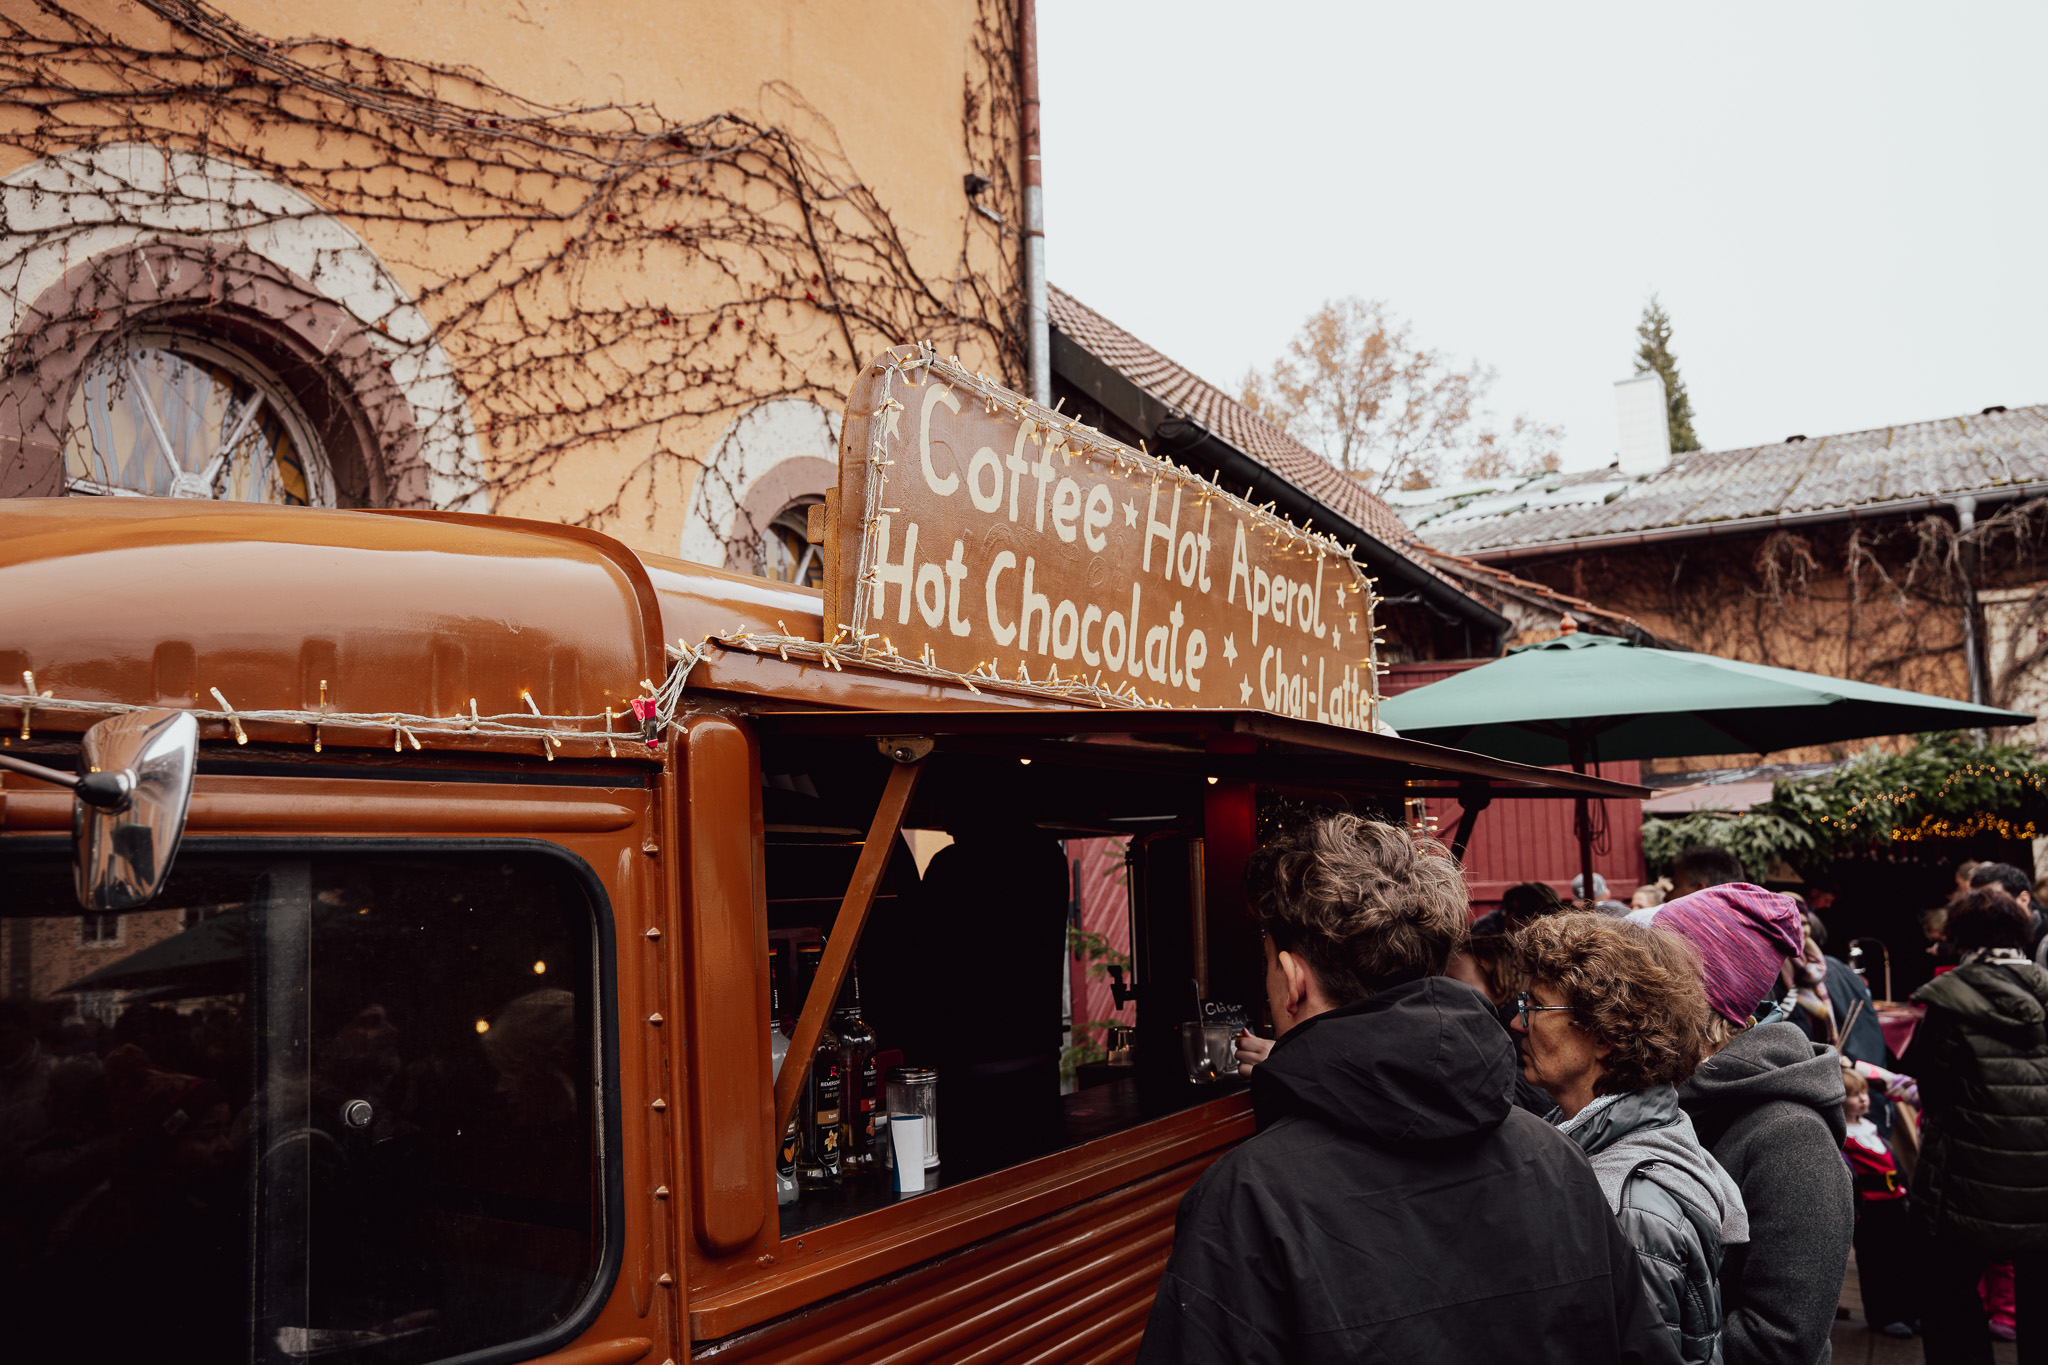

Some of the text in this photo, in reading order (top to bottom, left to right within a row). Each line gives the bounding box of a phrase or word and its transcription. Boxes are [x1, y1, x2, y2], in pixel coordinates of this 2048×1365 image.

[872, 513, 1370, 732] Hot Chocolate Chai-Latte
[919, 382, 1326, 647] Coffee Hot Aperol
